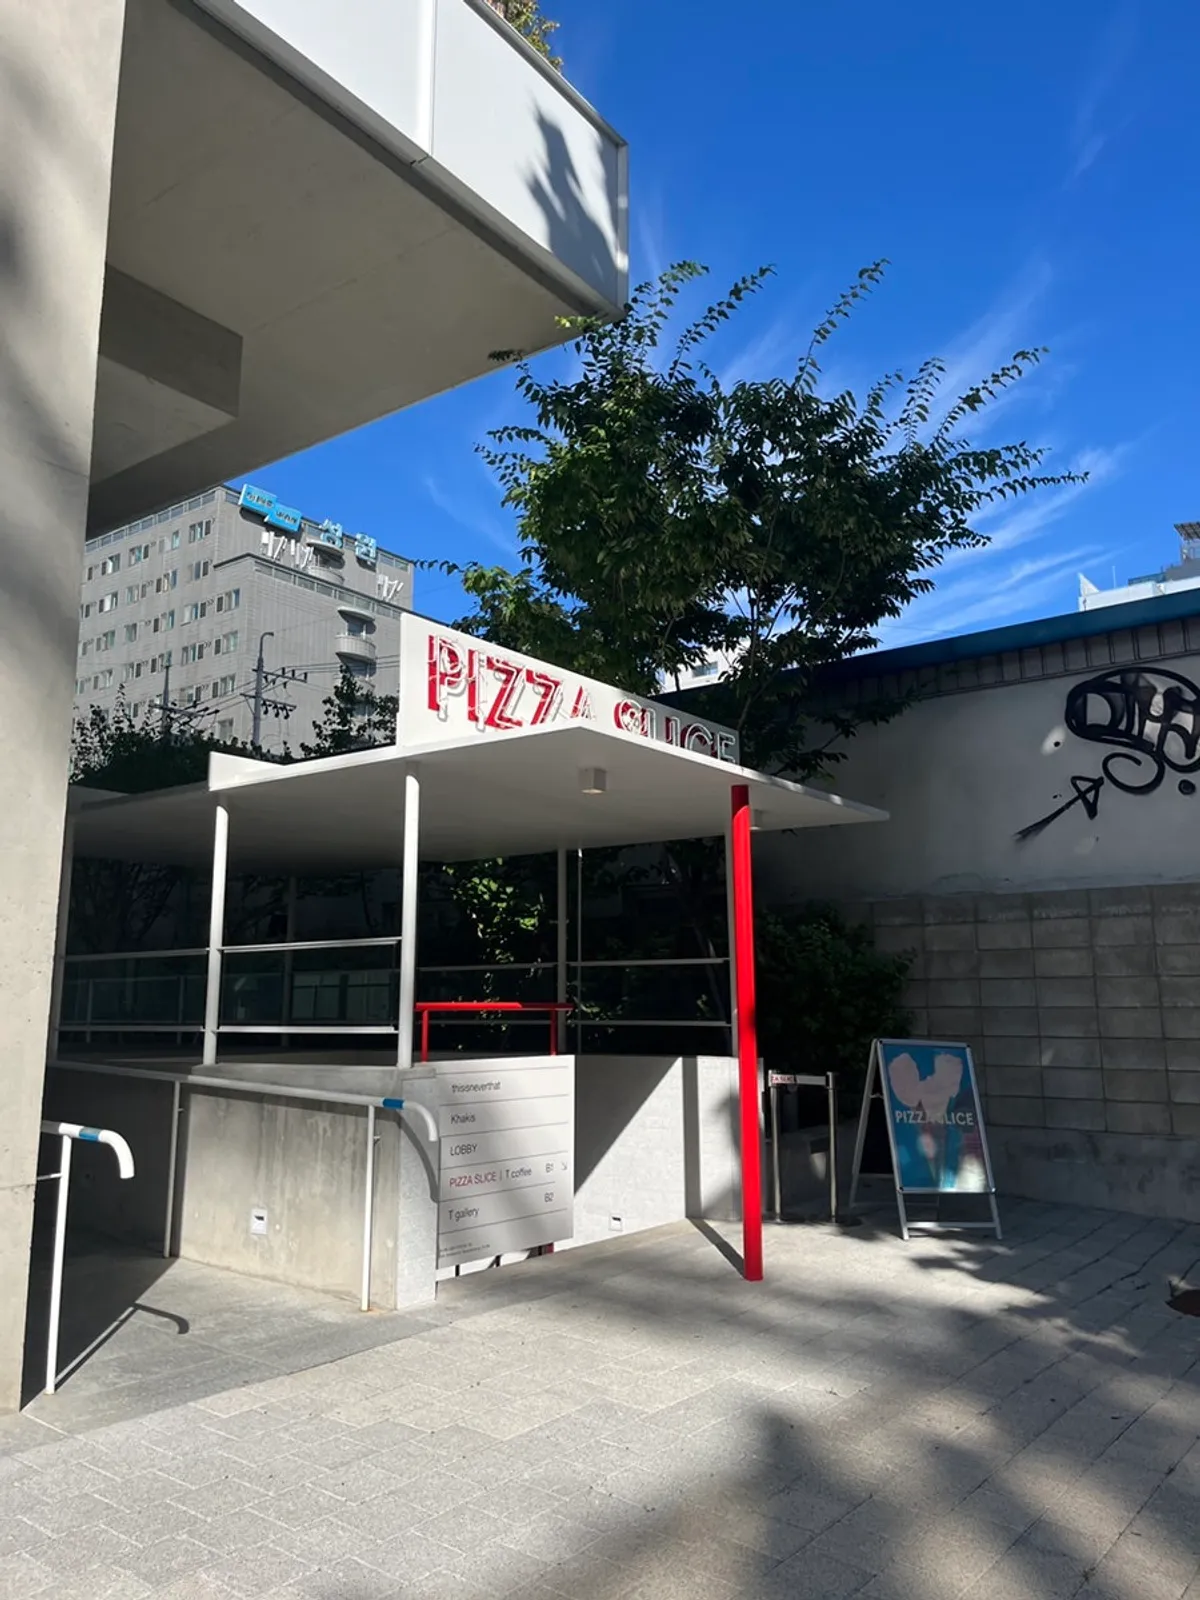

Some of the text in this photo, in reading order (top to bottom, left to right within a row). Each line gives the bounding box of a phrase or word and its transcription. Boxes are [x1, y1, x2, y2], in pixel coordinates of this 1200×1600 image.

[427, 634, 597, 733] PIZZA
[450, 1113, 476, 1124] Khakis
[937, 1111, 975, 1126] LICE
[450, 1144, 478, 1156] LOBBY
[449, 1176, 473, 1188] PIZZA
[474, 1171, 497, 1185] SLICE
[511, 1167, 532, 1179] coffee
[545, 1163, 554, 1173] B1
[454, 1207, 479, 1222] gallery
[544, 1192, 554, 1203] B2
